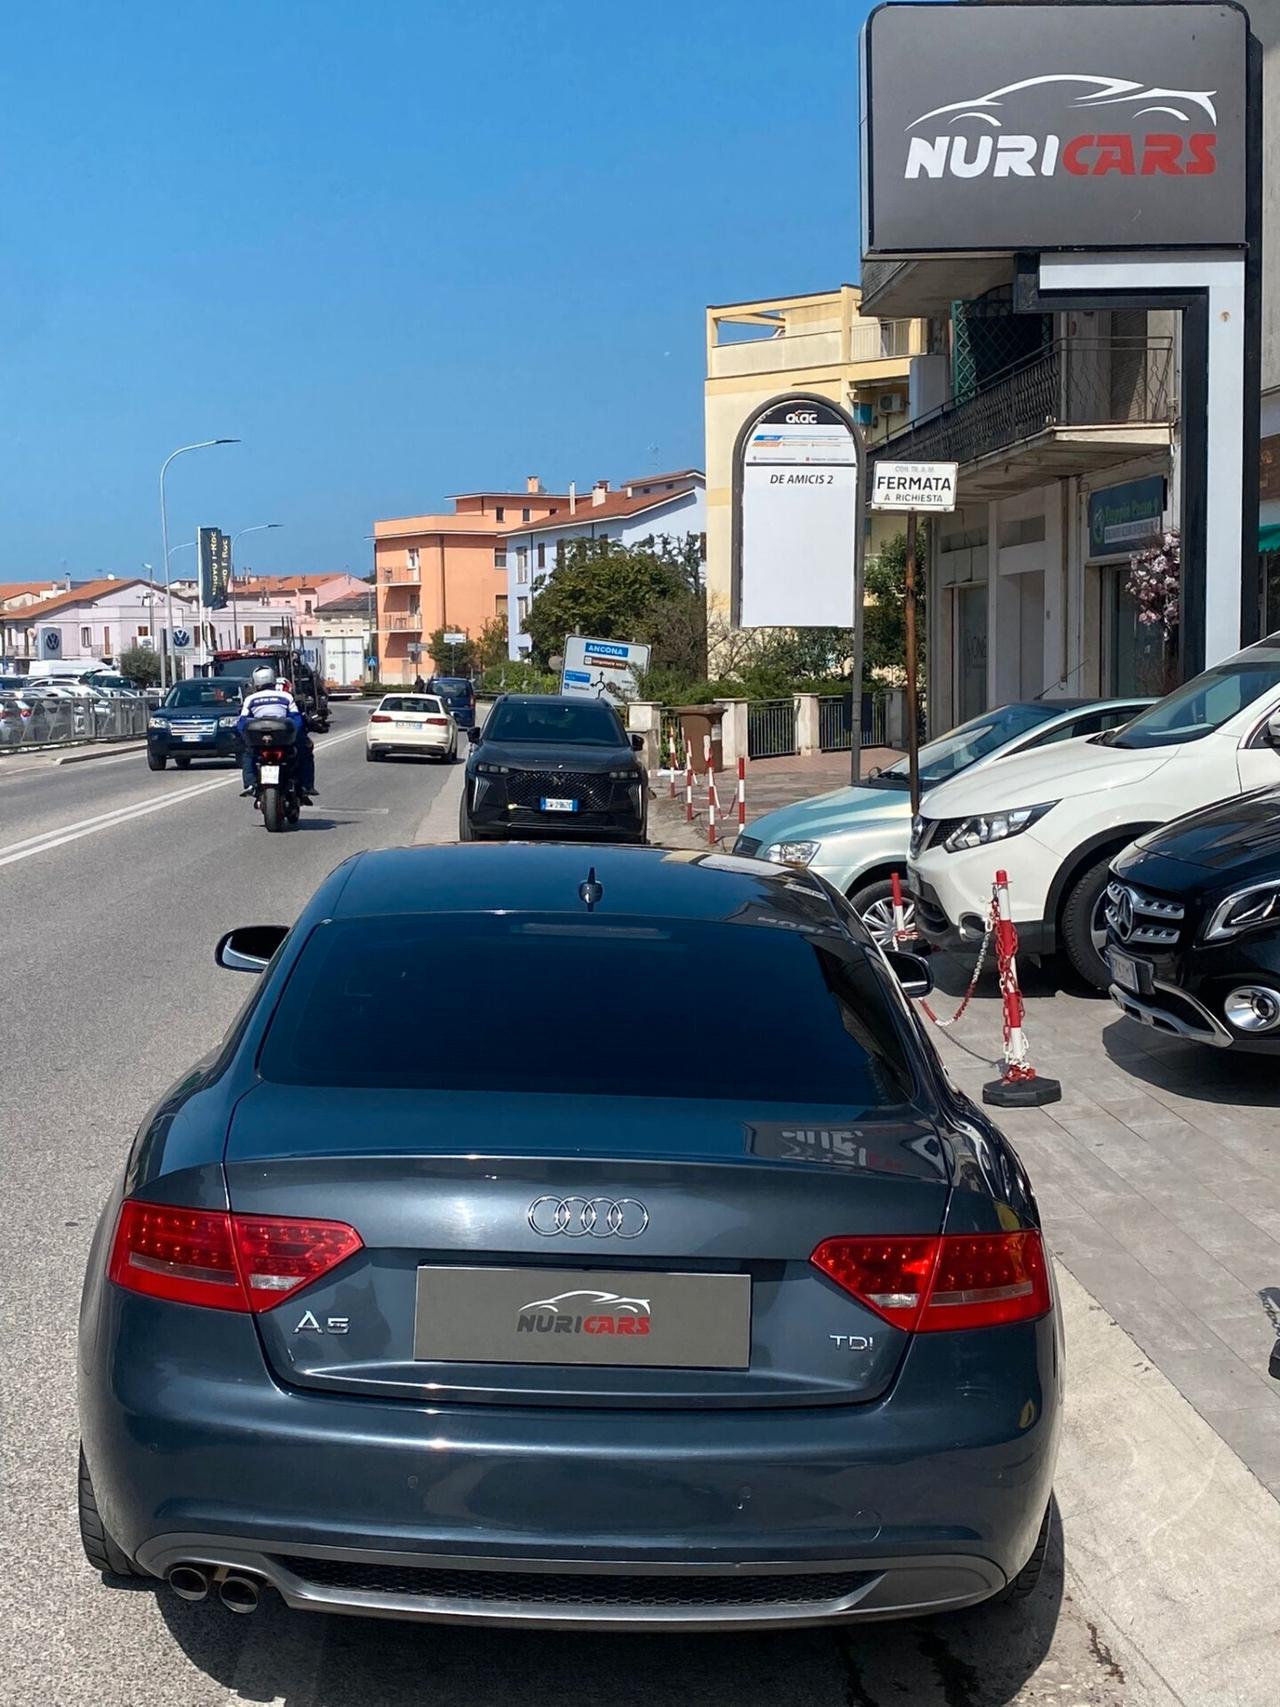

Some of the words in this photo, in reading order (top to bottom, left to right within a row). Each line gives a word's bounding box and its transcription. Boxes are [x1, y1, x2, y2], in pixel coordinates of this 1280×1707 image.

[904, 133, 1217, 179] NURICARS
[769, 474, 786, 484] DE
[787, 474, 825, 485] AMICIS
[826, 475, 834, 485] 2
[877, 476, 951, 491] FERMATA
[895, 493, 943, 502] RICHIESTA
[588, 644, 624, 656] ANCONA
[293, 1309, 350, 1335] A5
[517, 1313, 651, 1336] NURICARS
[829, 1335, 873, 1351] TDI
